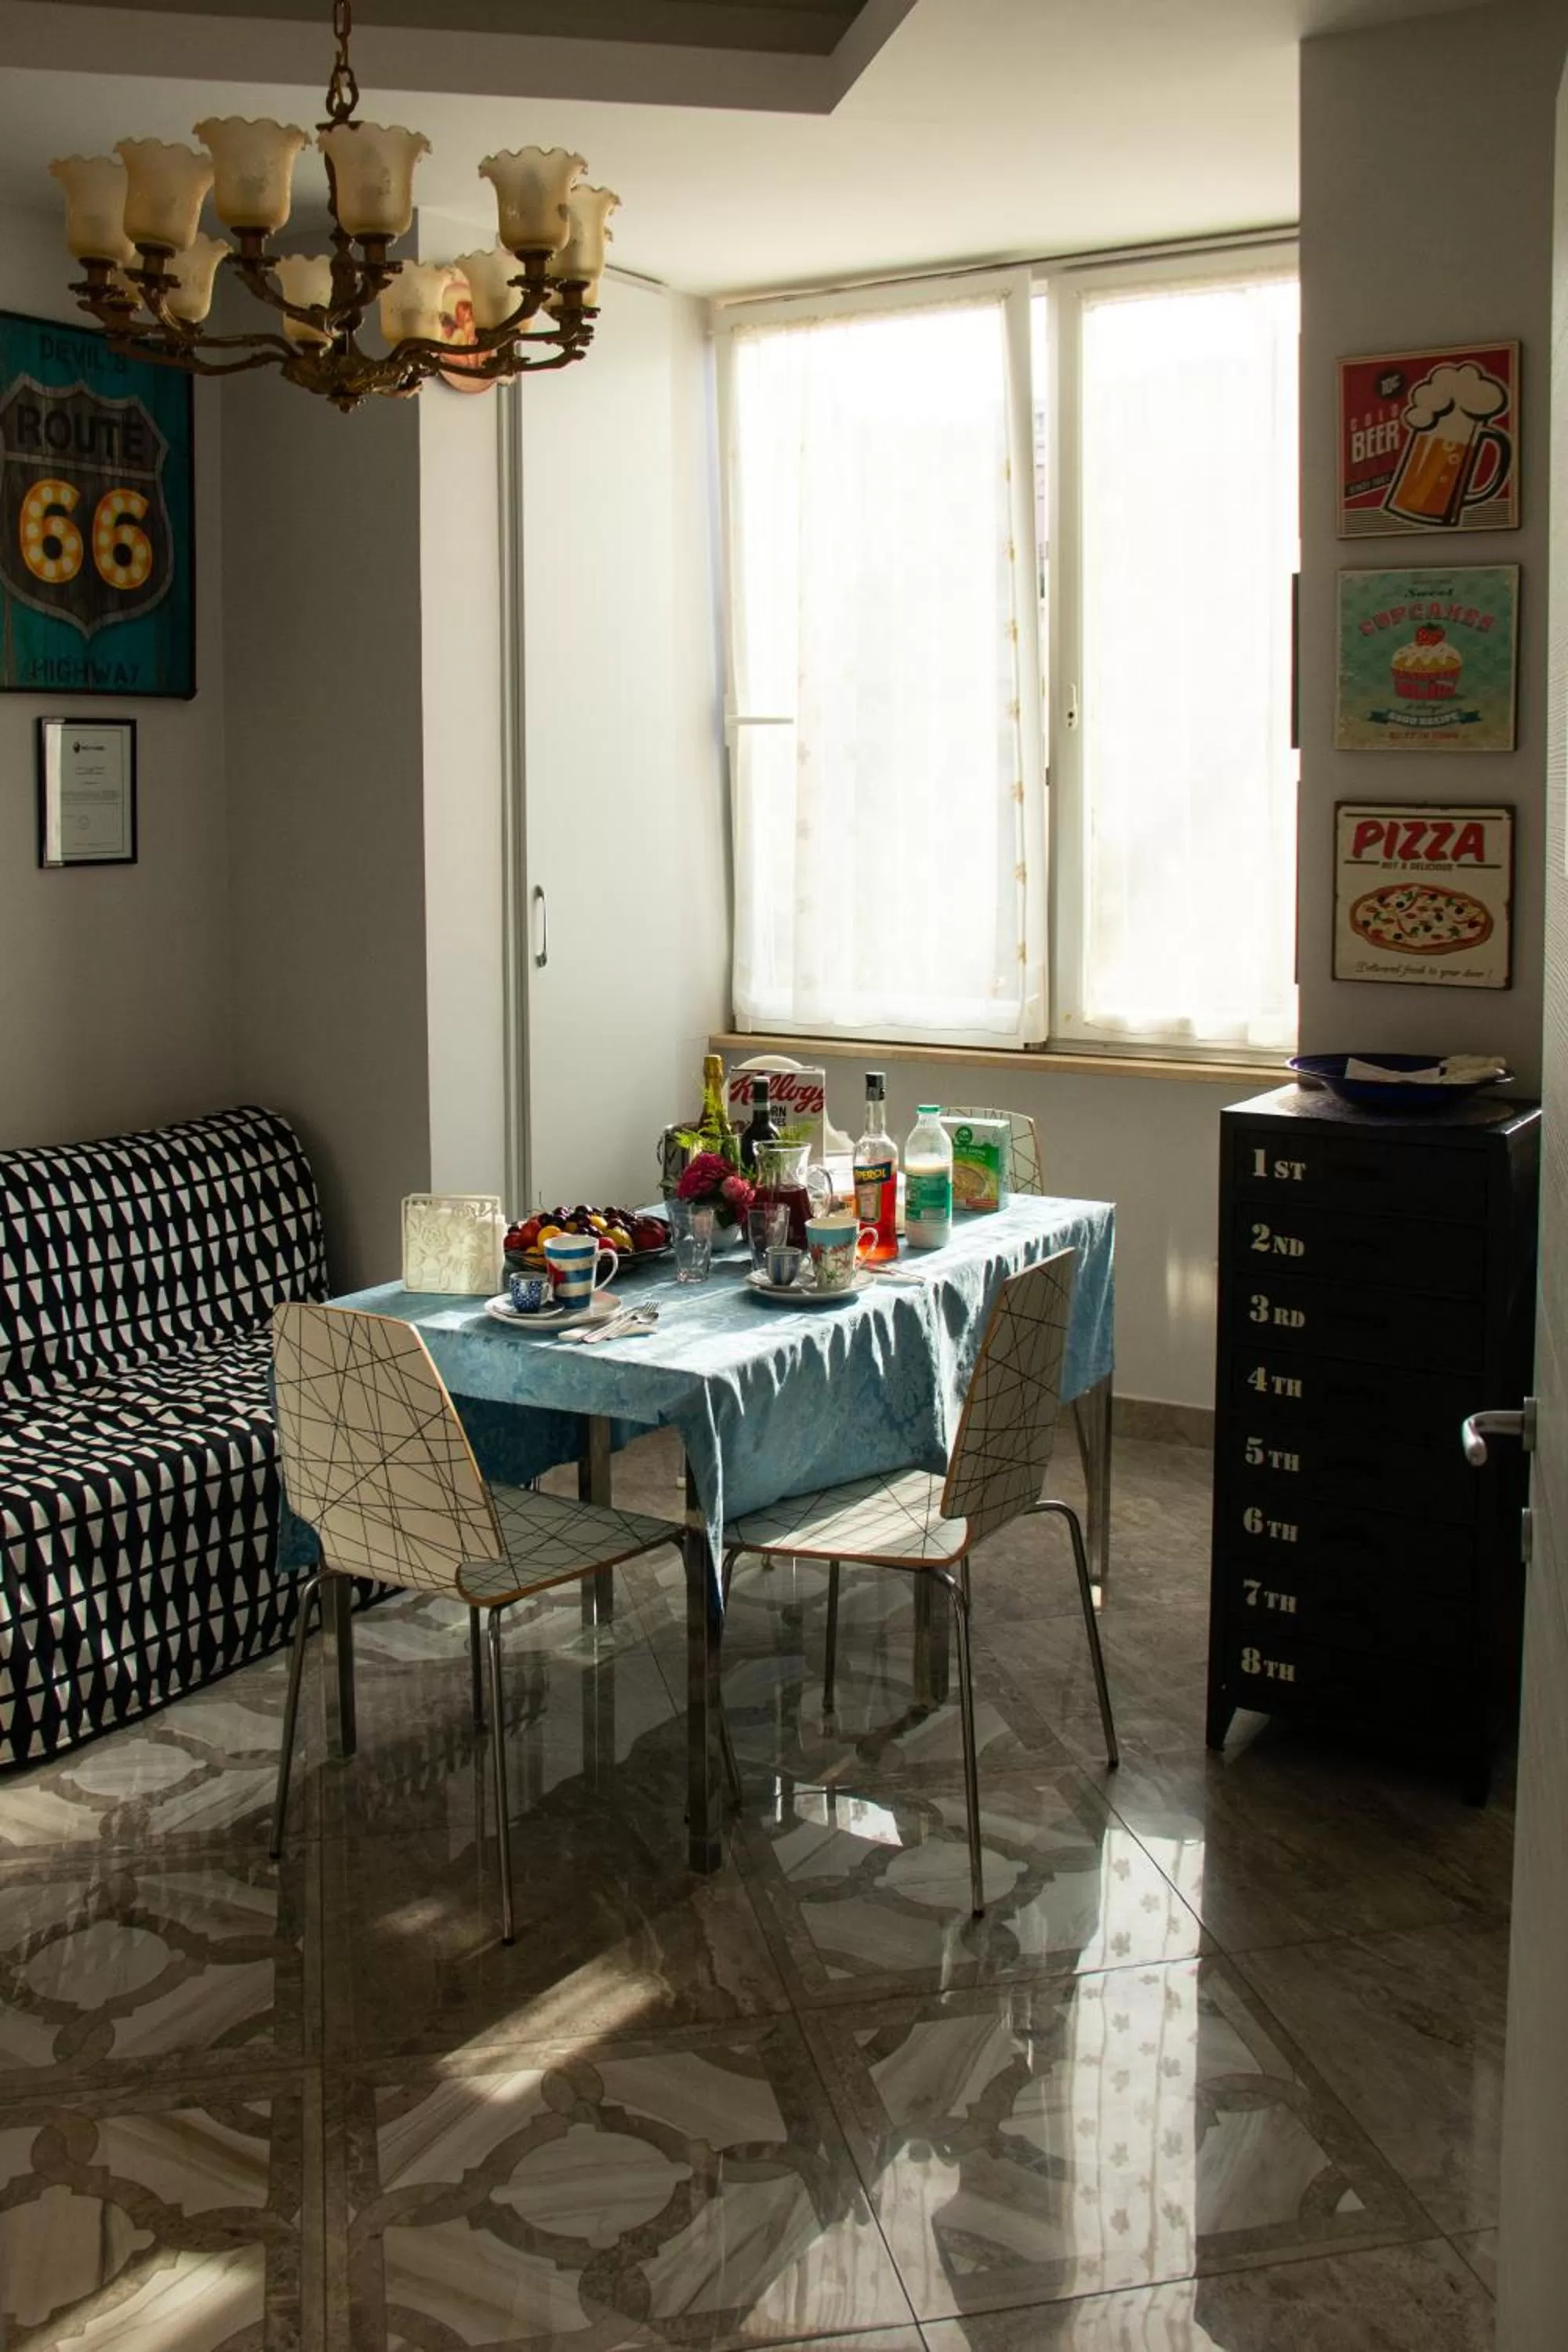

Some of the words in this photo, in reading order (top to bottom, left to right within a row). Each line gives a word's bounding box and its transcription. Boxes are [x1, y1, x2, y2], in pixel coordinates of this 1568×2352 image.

[16, 404, 144, 465] ROUTE
[1351, 419, 1400, 465] BEER
[19, 478, 152, 590] 66
[30, 657, 140, 687] HIGHWAY
[1352, 820, 1485, 863] PIZZA
[729, 1072, 823, 1113] Kllogg
[1252, 1149, 1307, 1181] 1ST
[1251, 1224, 1305, 1257] 2ND
[1250, 1295, 1305, 1327] 3RD
[1247, 1367, 1303, 1399] 4TH
[1244, 1436, 1299, 1472] 5TH
[1243, 1507, 1298, 1542] 6TH
[1243, 1579, 1296, 1613] 7TH
[1240, 1647, 1295, 1682] 8TH
